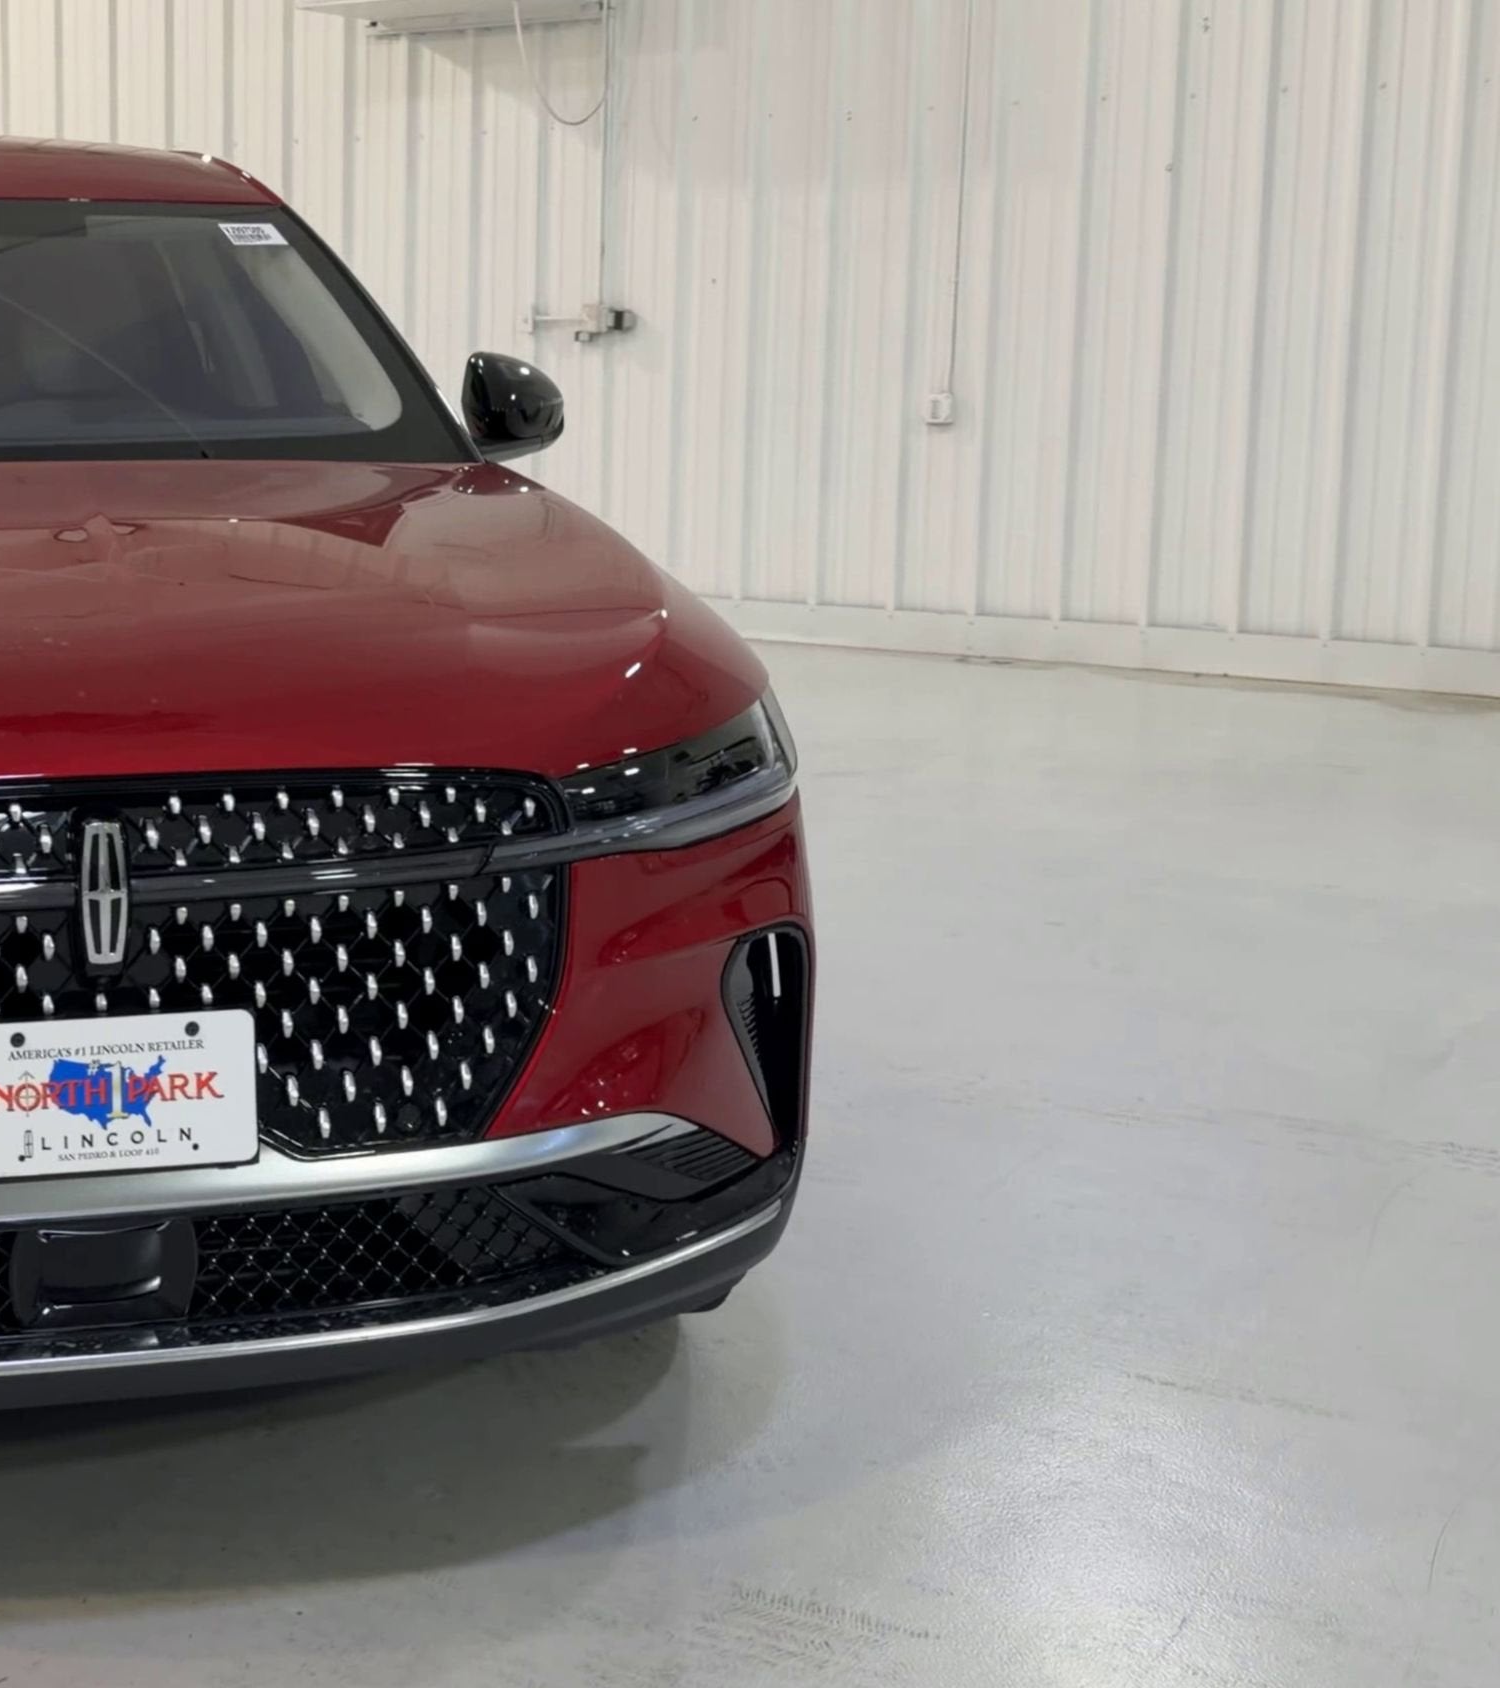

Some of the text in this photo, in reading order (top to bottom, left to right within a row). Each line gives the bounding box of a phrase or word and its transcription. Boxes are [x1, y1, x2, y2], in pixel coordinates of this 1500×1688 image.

[8, 1039, 205, 1061] AMERICA'S #1 LINCOLN RETAILER
[127, 1071, 225, 1103] PARK
[41, 1127, 192, 1151] LINCOLN
[58, 1153, 76, 1163] SAN
[78, 1150, 108, 1161] PEDRO
[119, 1148, 143, 1159] LOOP
